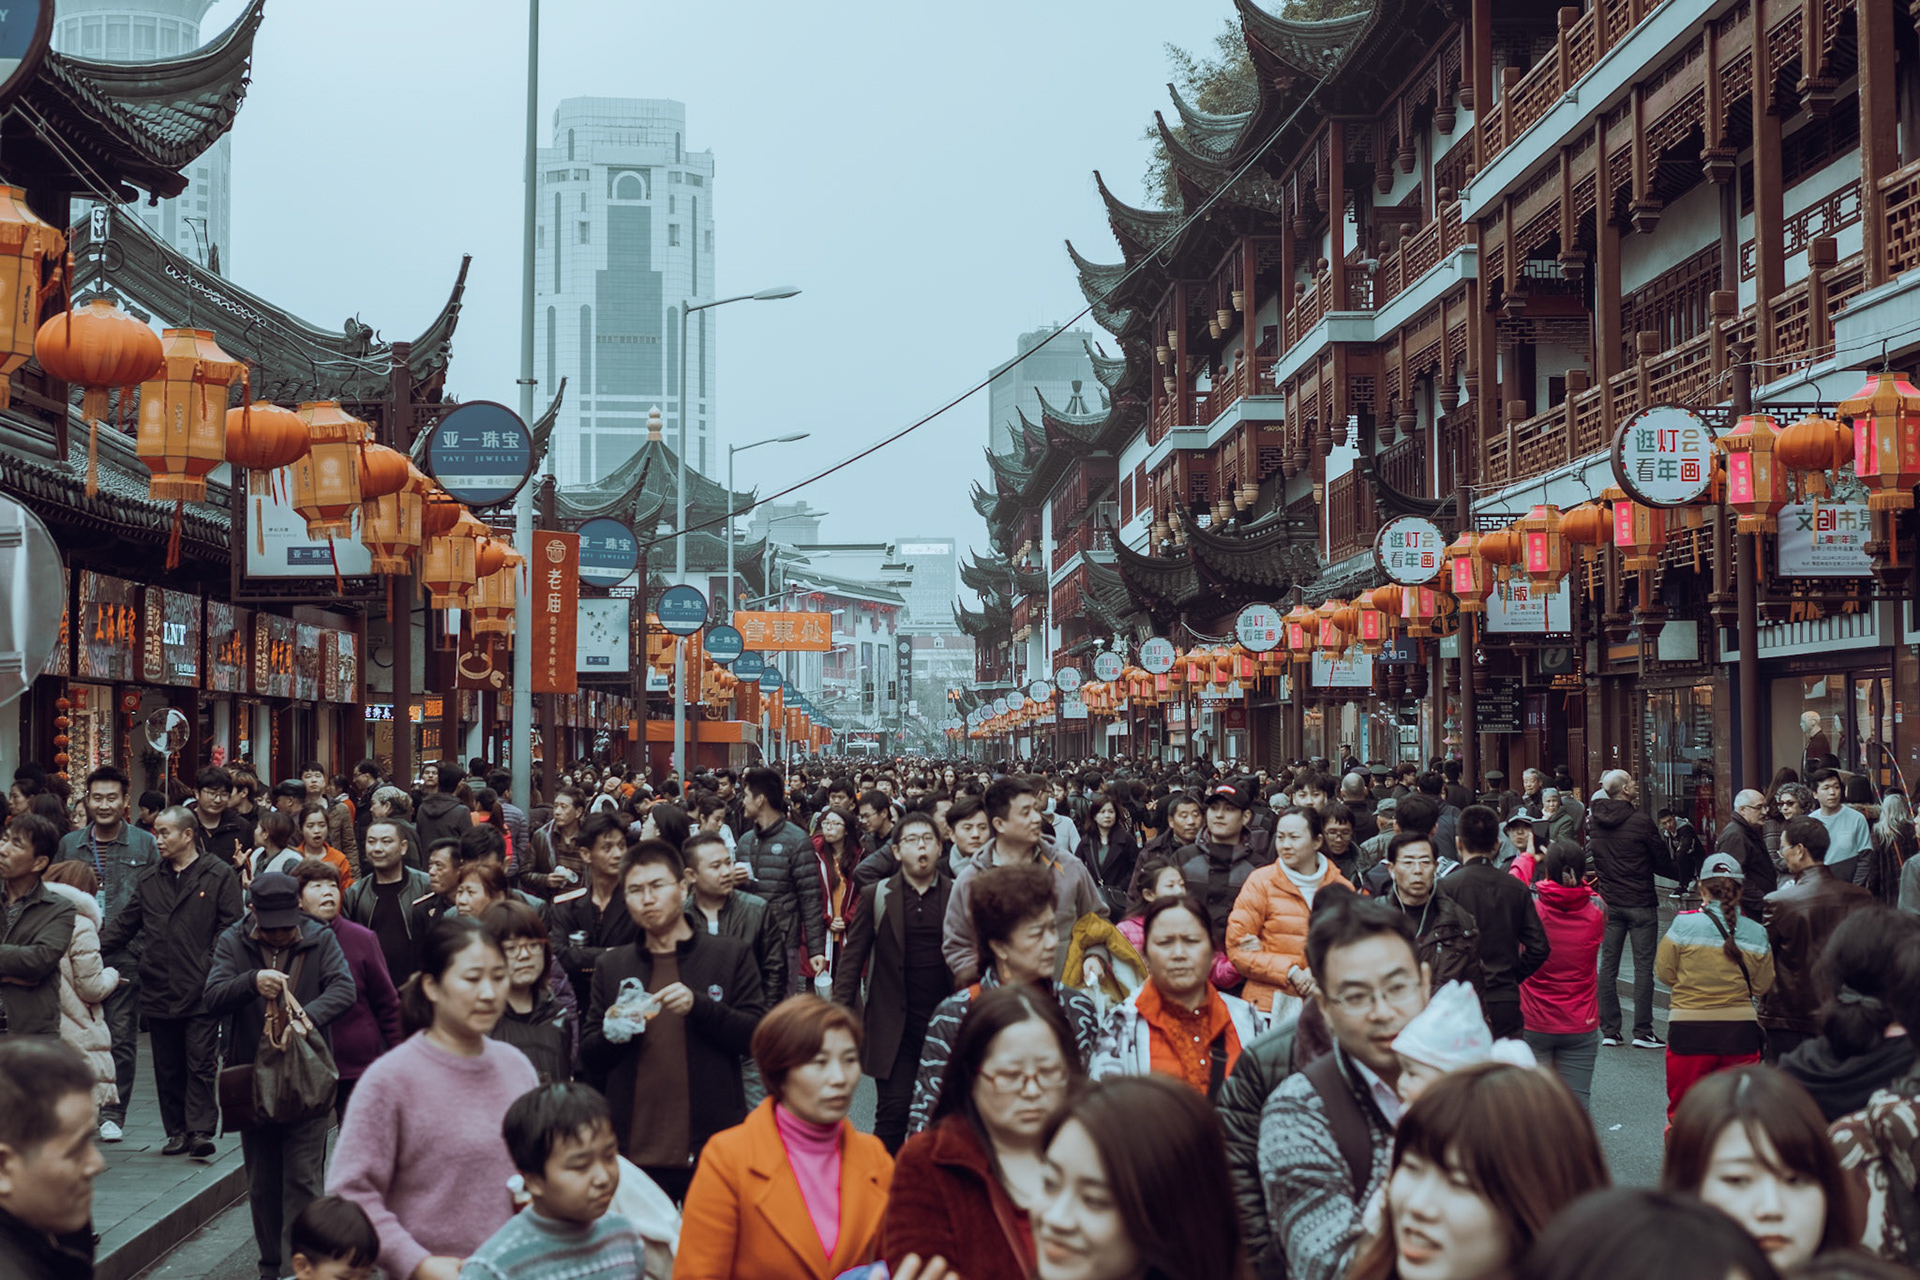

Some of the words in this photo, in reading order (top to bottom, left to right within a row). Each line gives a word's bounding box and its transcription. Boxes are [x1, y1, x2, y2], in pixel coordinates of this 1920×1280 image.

[442, 431, 519, 448] 亚一珠宝
[1636, 429, 1700, 453] 逛灯会
[475, 455, 519, 463] JEWELRY
[1636, 458, 1700, 482] 看年画
[579, 535, 631, 551] 亚一珠宝
[1390, 531, 1435, 548] 逛灯会
[292, 549, 331, 559] 亚一珠宝
[1390, 551, 1435, 568] 看年画
[547, 568, 563, 613] 老庙
[663, 599, 702, 610] 亚一珠宝
[743, 619, 824, 643] 售票处
